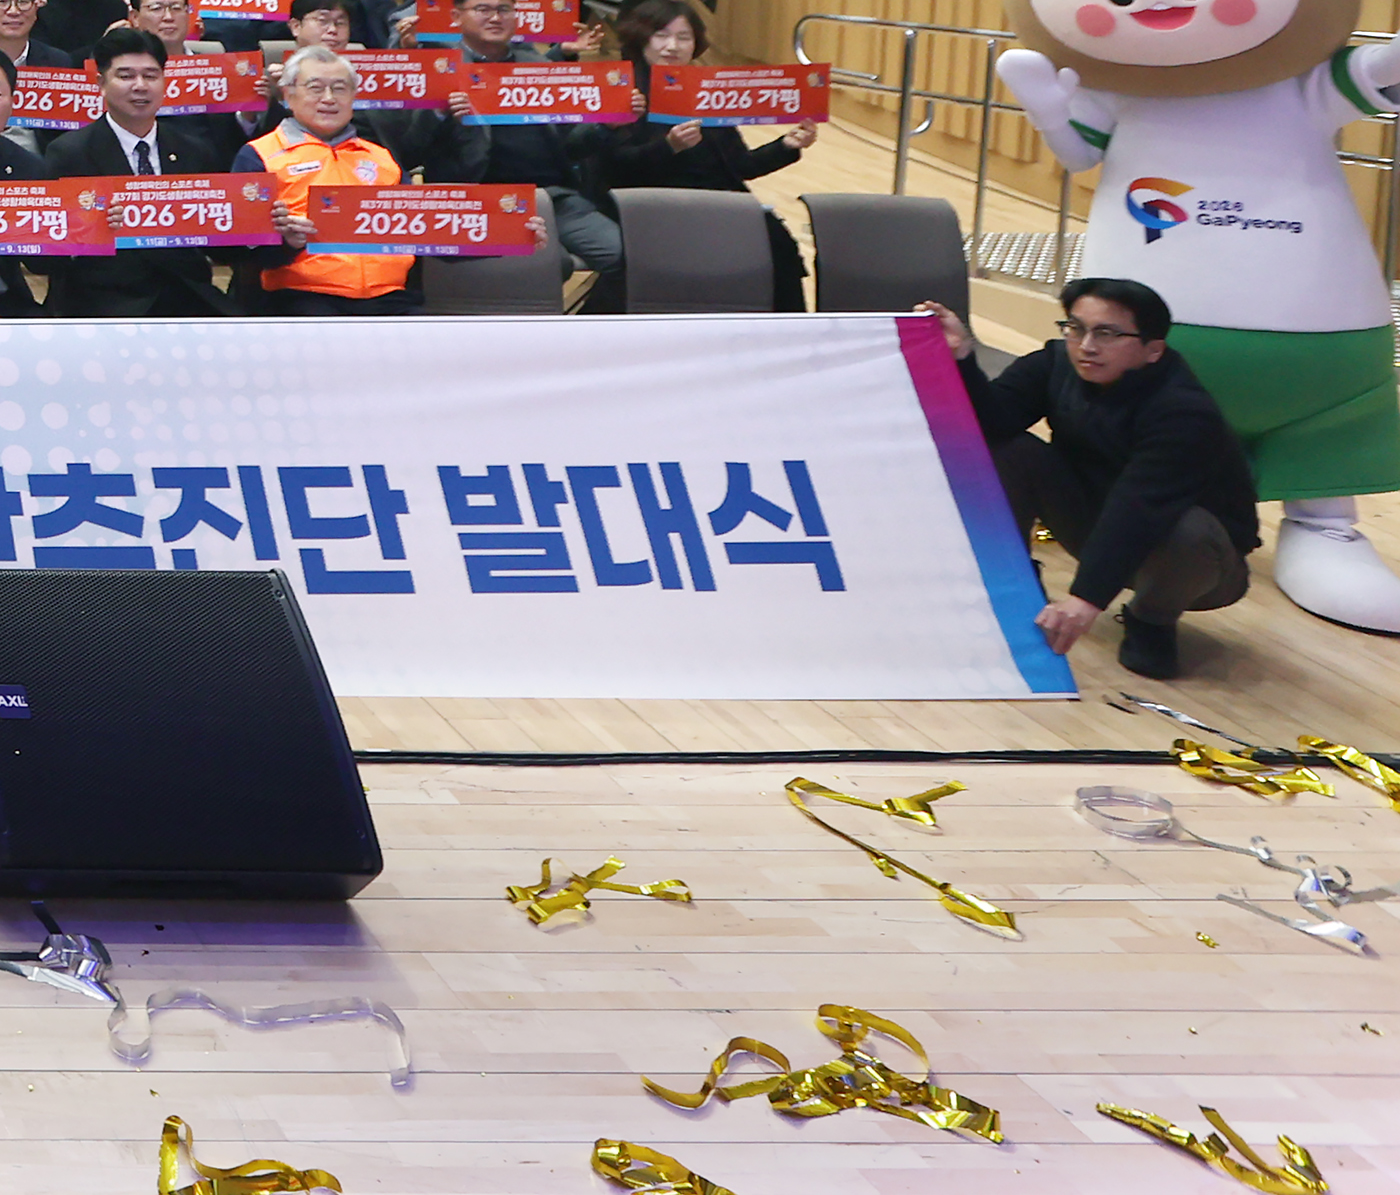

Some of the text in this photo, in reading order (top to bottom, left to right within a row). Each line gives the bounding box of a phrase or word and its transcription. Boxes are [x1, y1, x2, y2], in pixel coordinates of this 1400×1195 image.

[497, 87, 601, 111] 2026 가평
[696, 88, 800, 113] 2026 가평
[181, 202, 233, 232] 가평
[1197, 200, 1244, 212] 2026
[15, 210, 68, 241] 가평
[354, 212, 488, 242] 2026 가평
[1196, 213, 1303, 234] GaPyeong
[437, 459, 847, 595] 발대식
